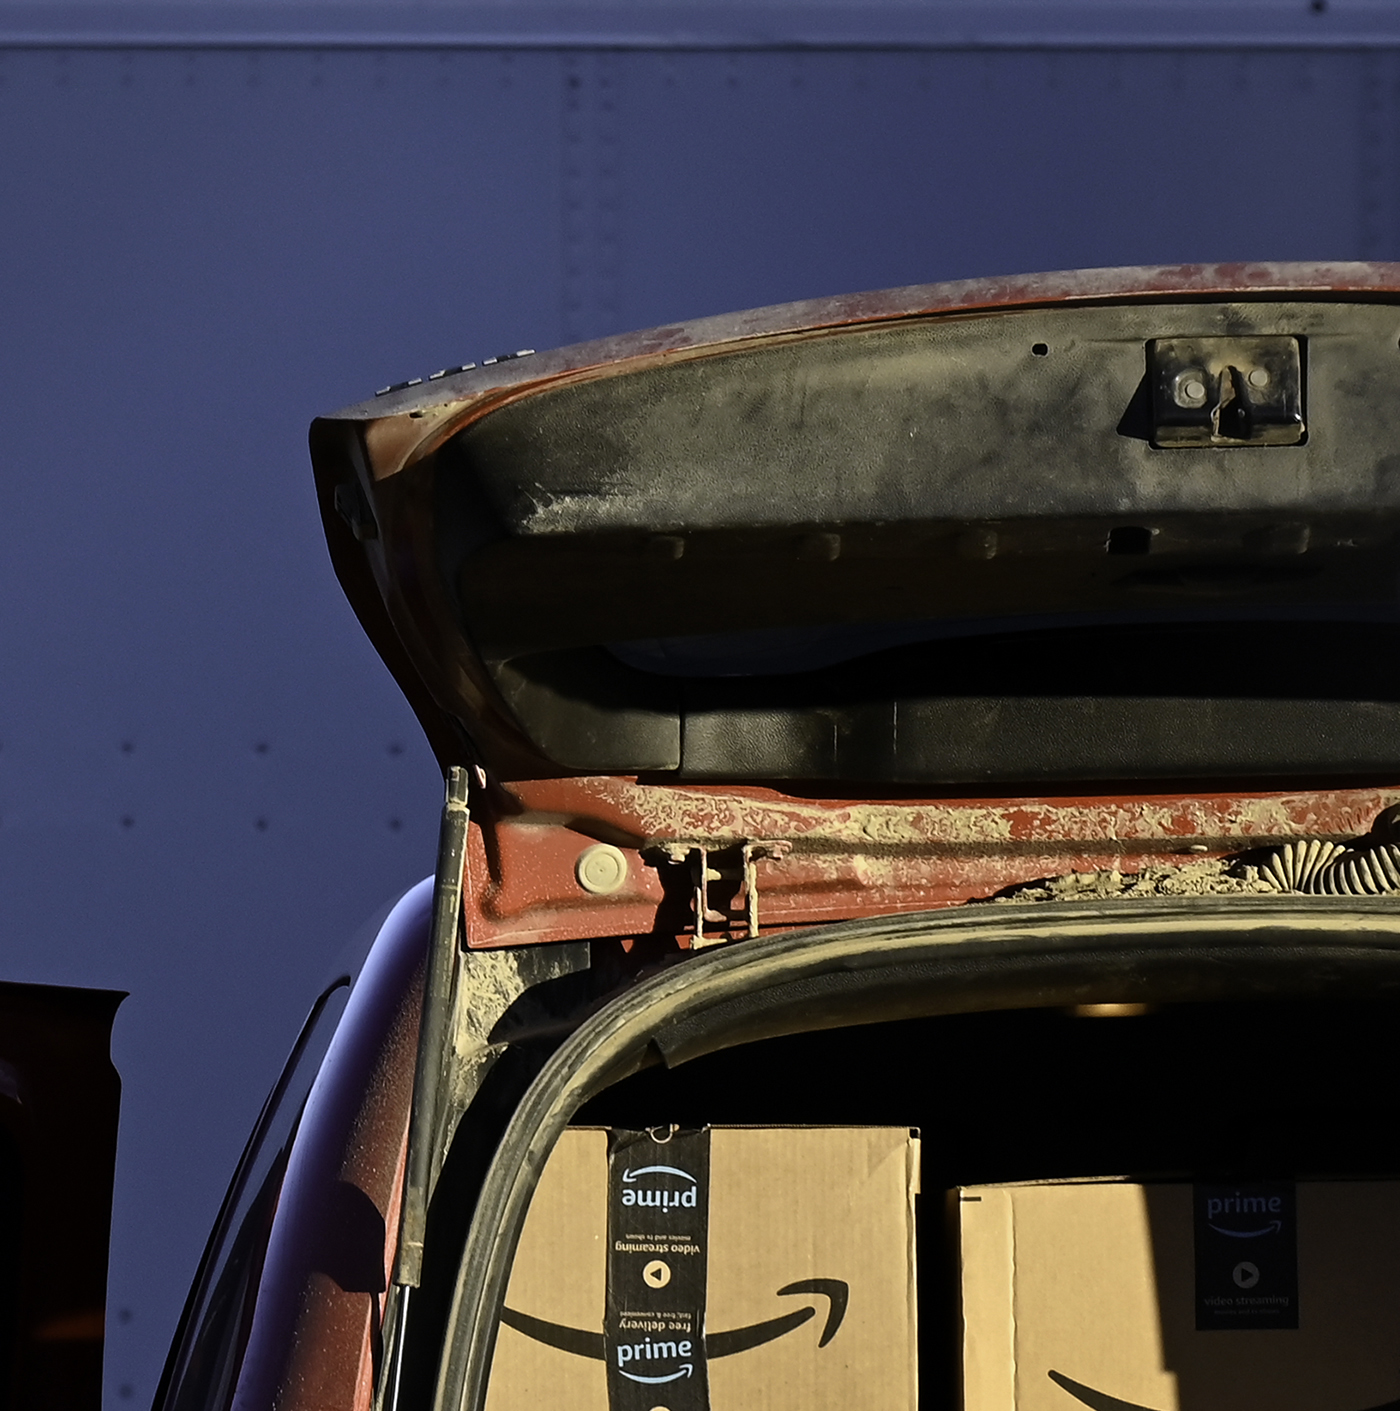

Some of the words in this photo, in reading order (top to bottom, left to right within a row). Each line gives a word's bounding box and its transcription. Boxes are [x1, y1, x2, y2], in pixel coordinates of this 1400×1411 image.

[622, 1186, 697, 1213] prime
[1207, 1191, 1281, 1219] prime
[614, 1240, 669, 1254] streaming
[671, 1244, 701, 1256] video
[1204, 1295, 1233, 1307] video
[1235, 1294, 1290, 1308] streaming
[619, 1318, 666, 1332] delivery
[668, 1322, 692, 1333] free
[617, 1337, 692, 1367] prime
